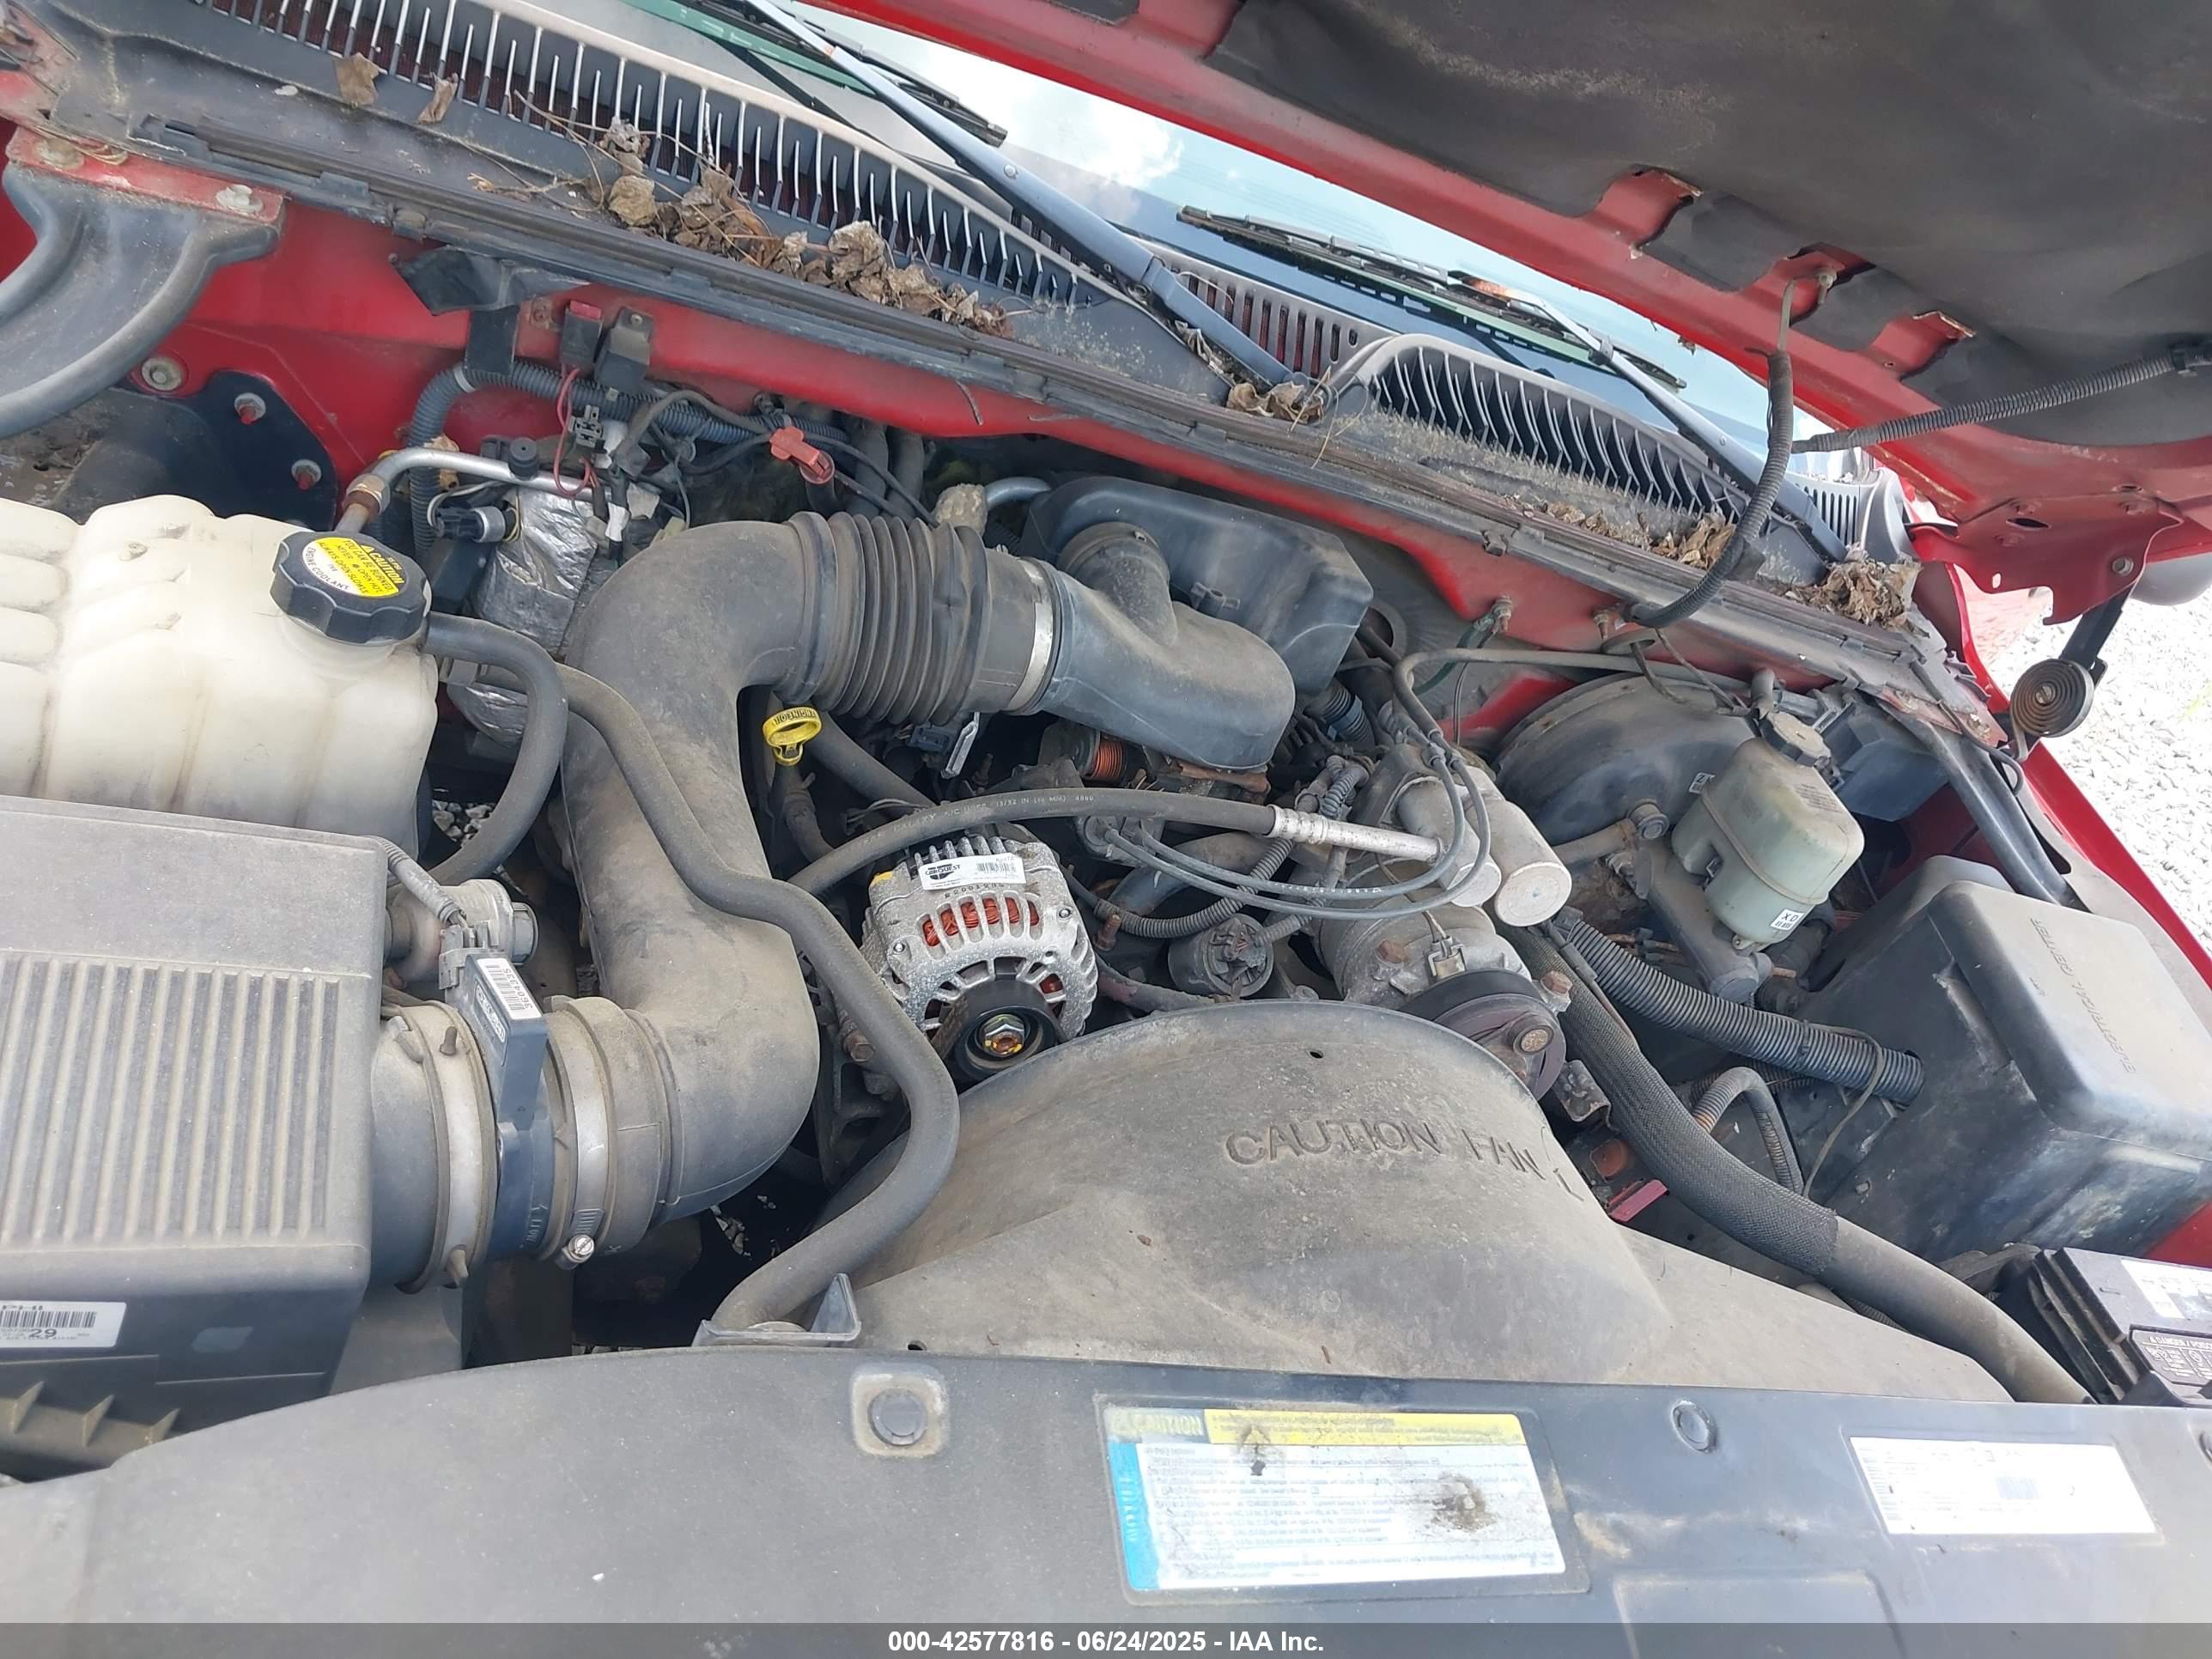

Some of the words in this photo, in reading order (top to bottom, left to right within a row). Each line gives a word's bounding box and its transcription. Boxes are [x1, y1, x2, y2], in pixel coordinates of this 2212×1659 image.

[307, 546, 317, 570] ENGINE
[313, 566, 350, 591] COOLANT
[319, 542, 339, 561] ALWAYS
[335, 557, 351, 574] OPEN
[347, 573, 370, 595] SLOWLY
[337, 544, 354, 560] NEVER
[357, 567, 373, 583] OPEN
[343, 540, 356, 551] YOU
[355, 550, 367, 562] CAN
[364, 560, 374, 568] BE
[370, 552, 404, 585] CAUTION
[925, 863, 962, 877] CARQUEST
[2030, 917, 2075, 977] CENTER
[2071, 981, 2138, 1074] ELECTRICAL
[1224, 1119, 1442, 1165] CAUTION
[1460, 1127, 1547, 1181] FAN
[29, 1328, 58, 1338] 29
